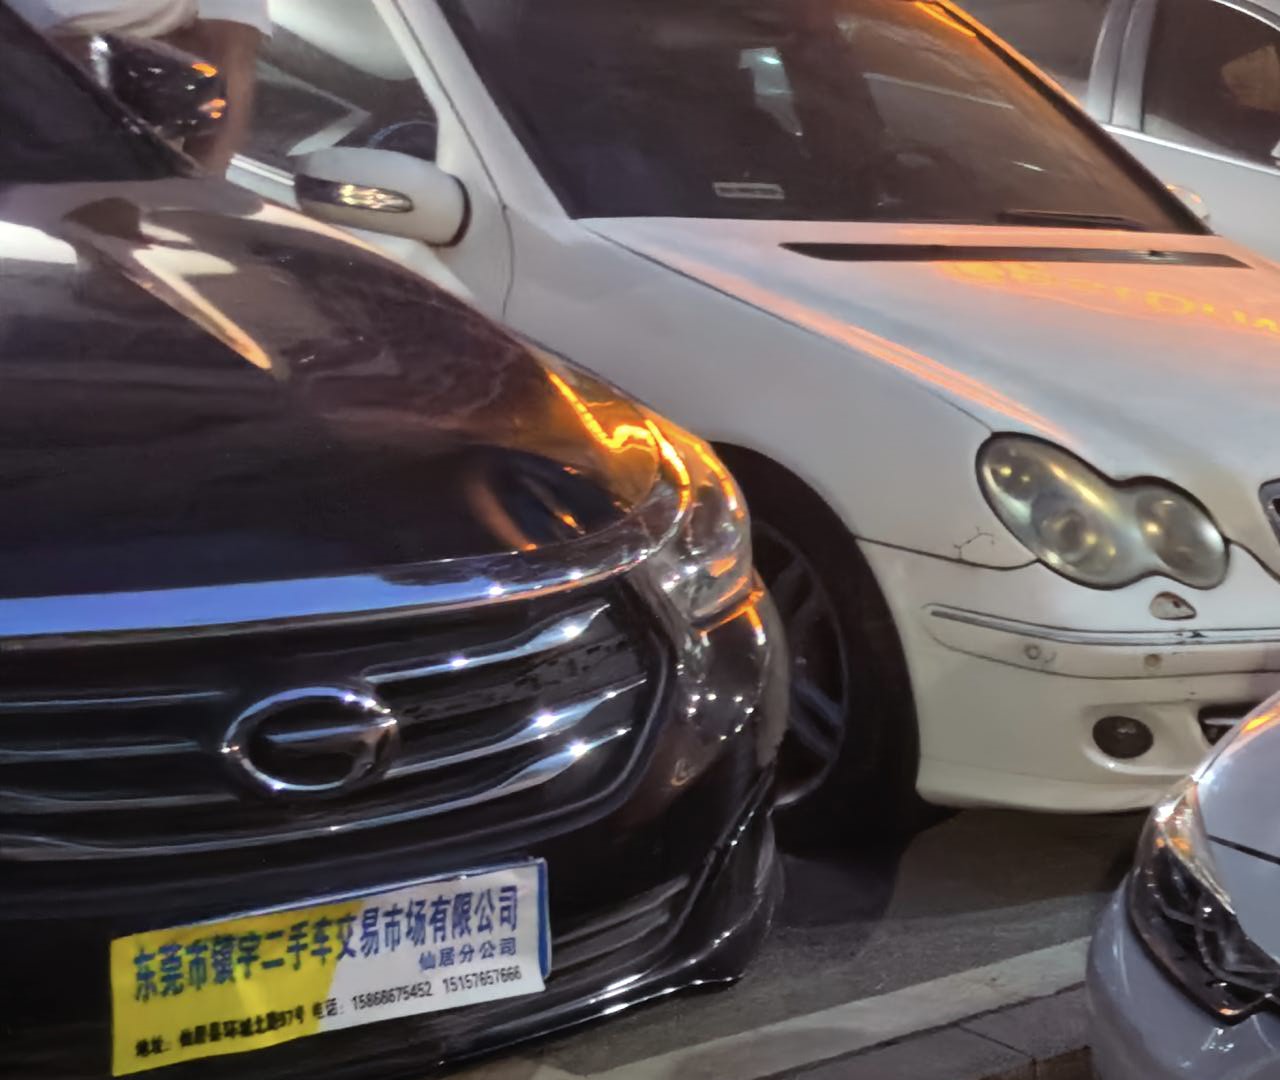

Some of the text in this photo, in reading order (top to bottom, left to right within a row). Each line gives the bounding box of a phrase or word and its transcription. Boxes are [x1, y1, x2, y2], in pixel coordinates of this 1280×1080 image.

[418, 938, 517, 971] 仙居分公司
